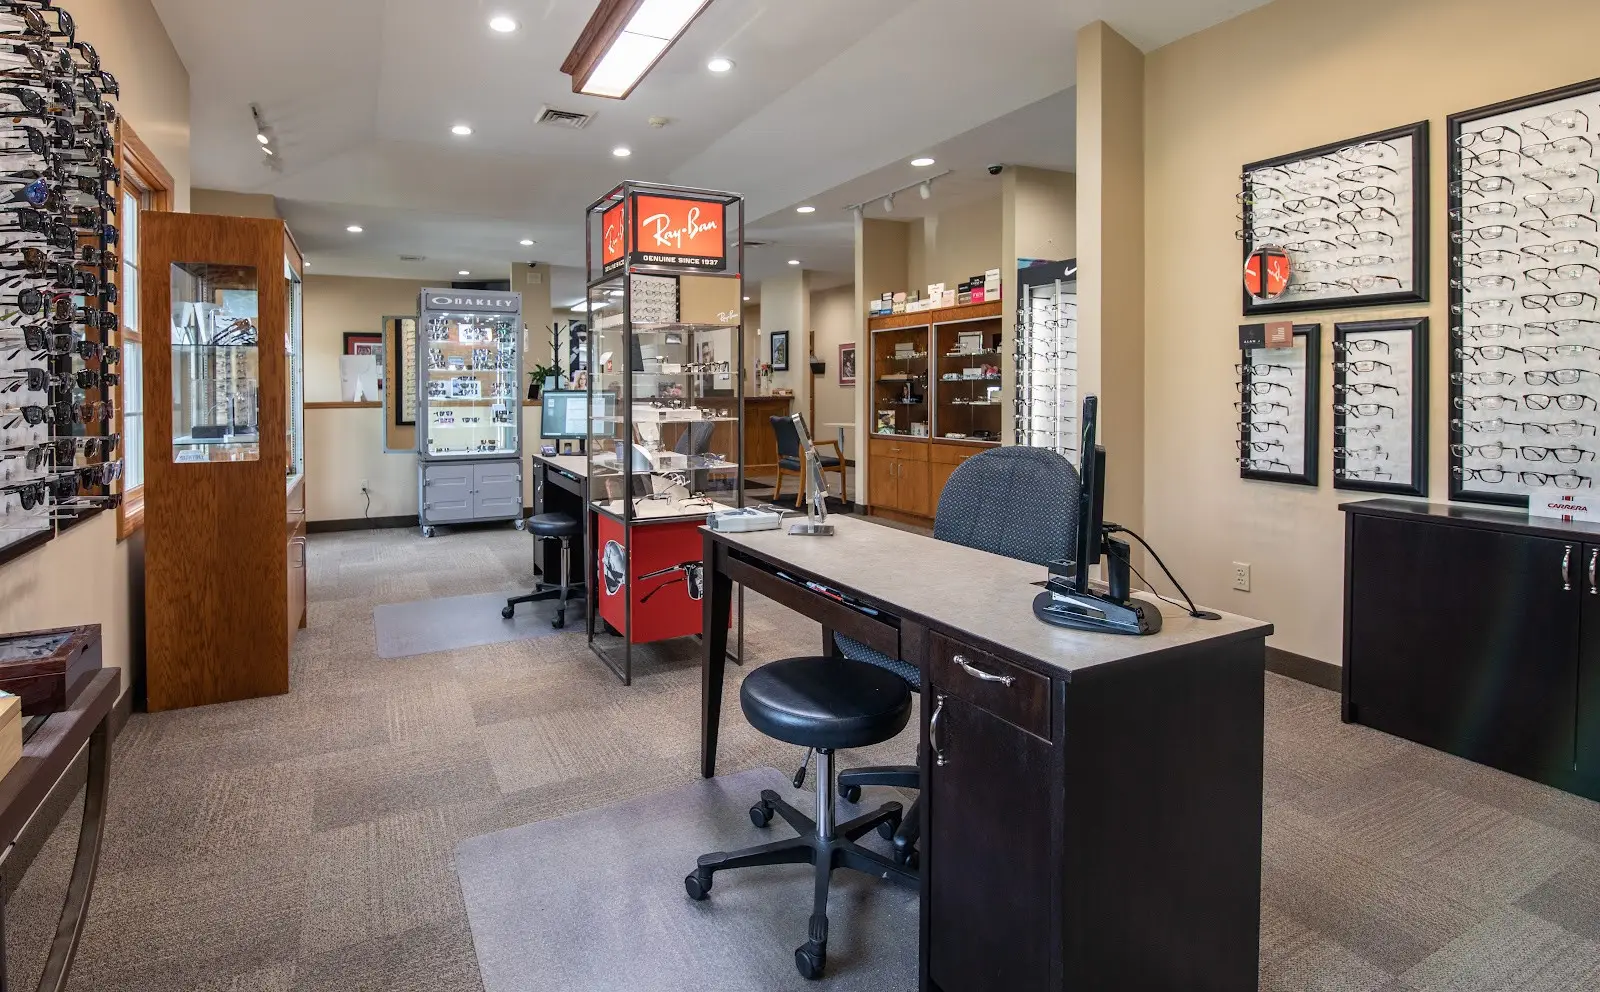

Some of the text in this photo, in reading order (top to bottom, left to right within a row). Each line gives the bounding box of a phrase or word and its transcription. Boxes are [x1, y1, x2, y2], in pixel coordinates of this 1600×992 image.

[643, 207, 717, 248] Ray-Ban
[643, 255, 676, 263] GENUINE
[678, 257, 699, 265] SINCE
[454, 298, 512, 306] OAKLEY
[1547, 503, 1587, 511] CARRERA
